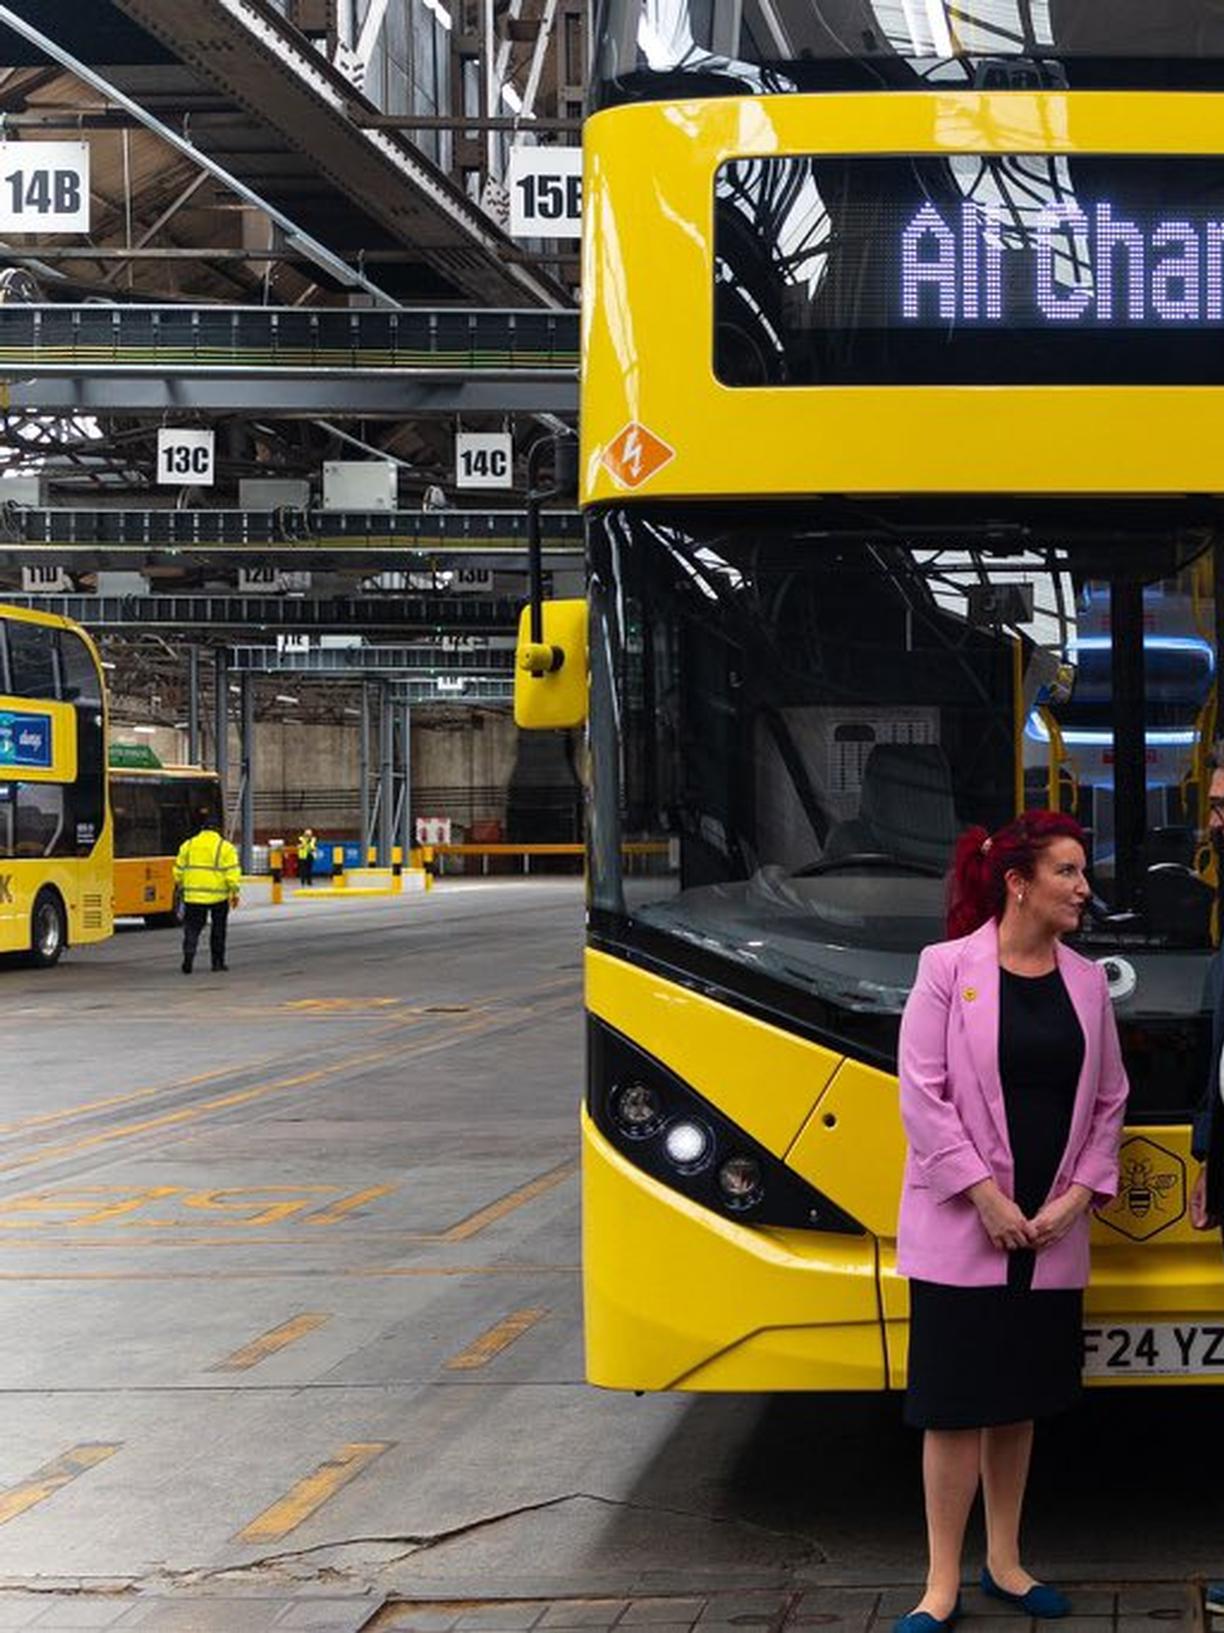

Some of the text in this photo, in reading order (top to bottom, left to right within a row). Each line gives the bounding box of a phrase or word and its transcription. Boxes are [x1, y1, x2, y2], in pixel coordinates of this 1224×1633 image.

[6, 170, 80, 213] 14B
[901, 200, 1002, 319] All
[163, 446, 209, 474] 13C
[460, 449, 507, 477] 14C
